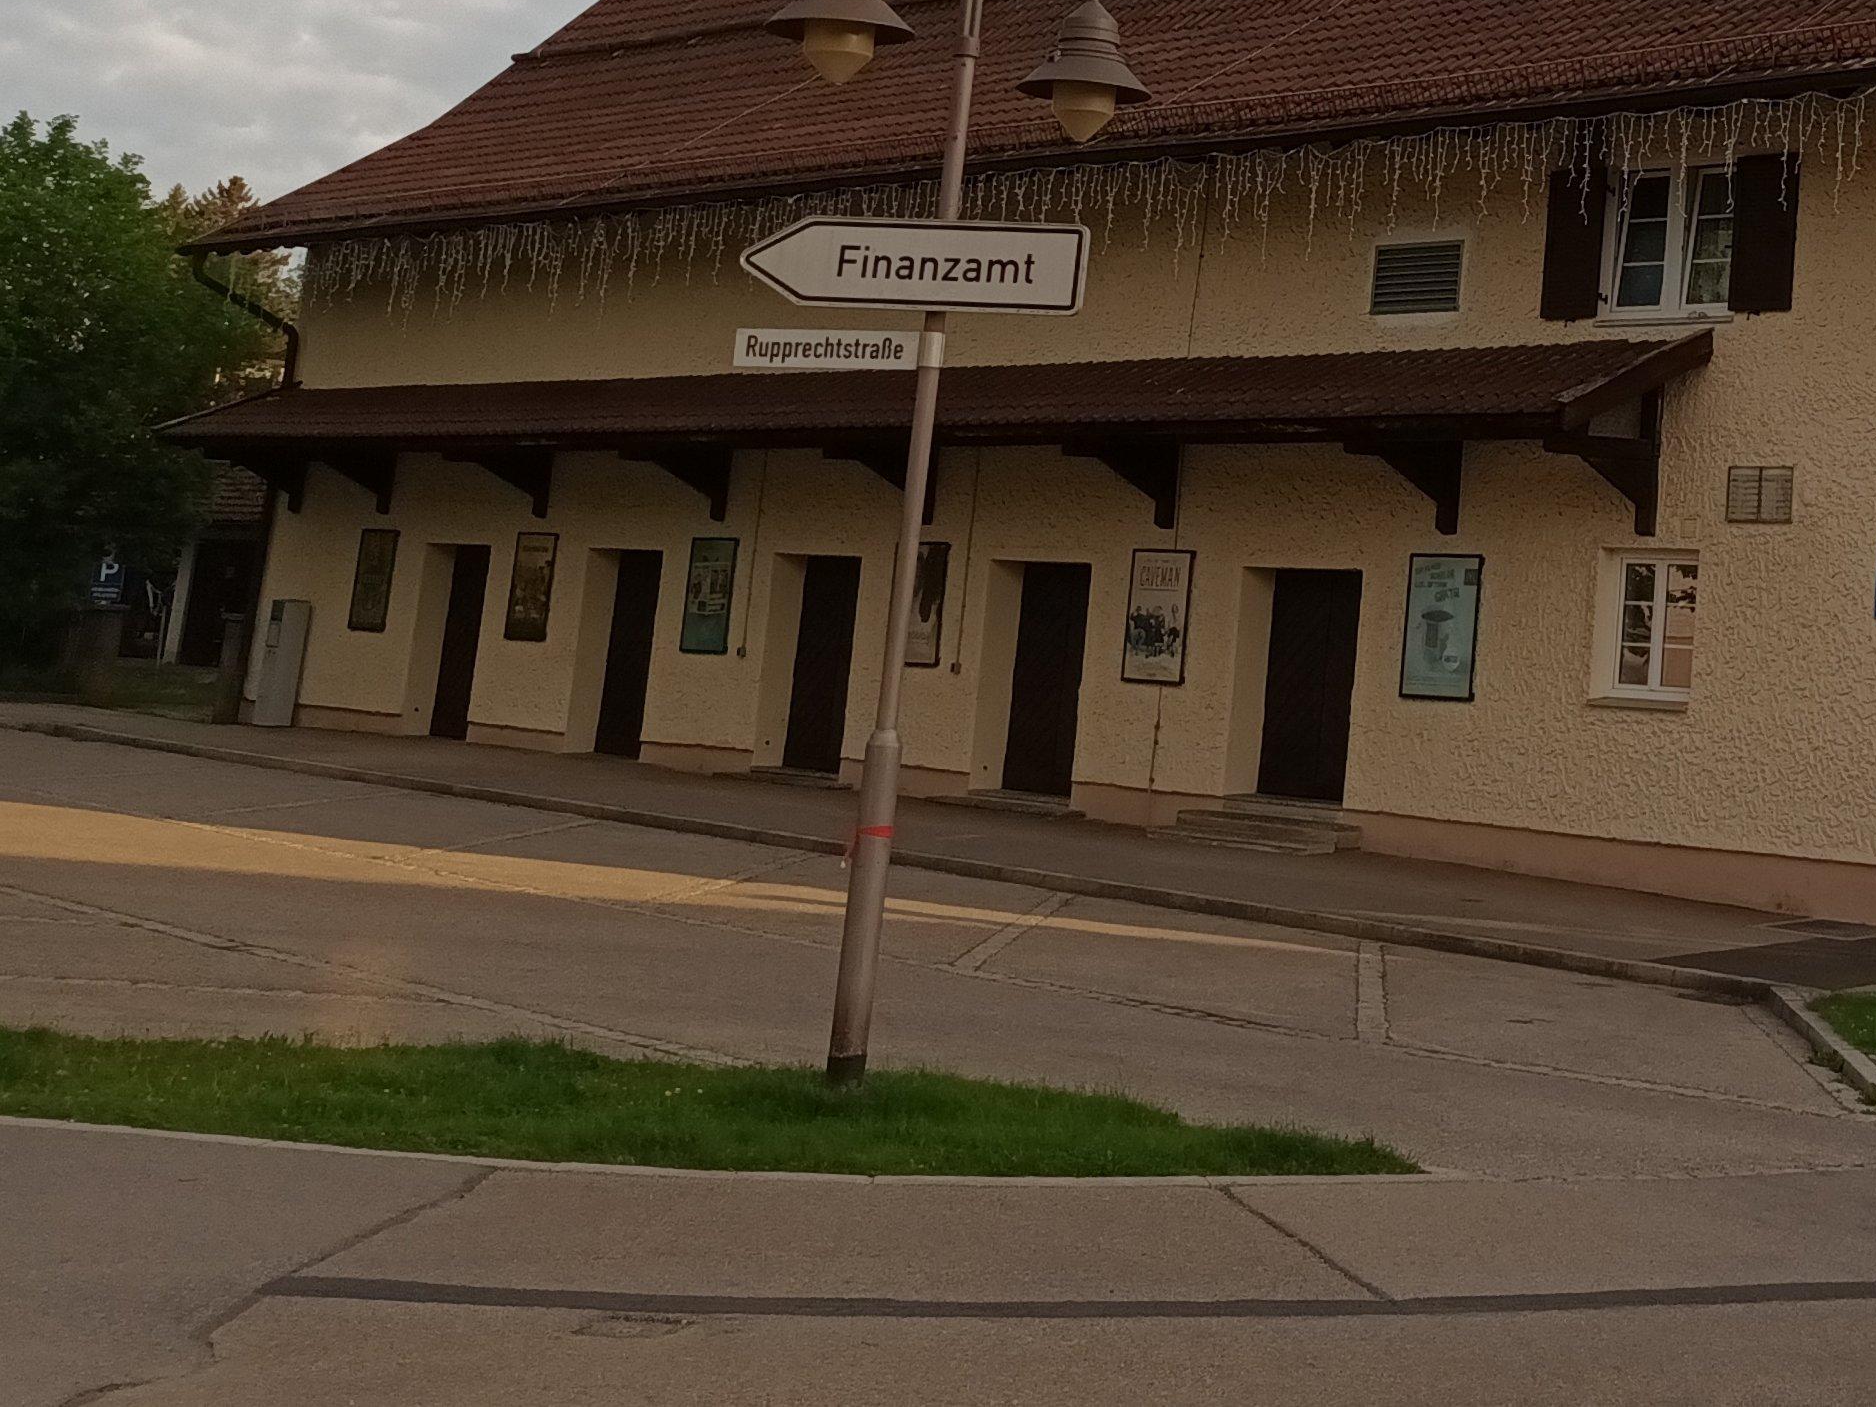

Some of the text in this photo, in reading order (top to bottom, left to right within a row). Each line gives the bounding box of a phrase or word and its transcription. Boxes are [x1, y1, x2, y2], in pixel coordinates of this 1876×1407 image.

[835, 244, 1036, 285] Finanzamt
[745, 334, 905, 362] Rupprechtstraße
[100, 561, 119, 582] P
[1139, 565, 1182, 588] CAVEMAN
